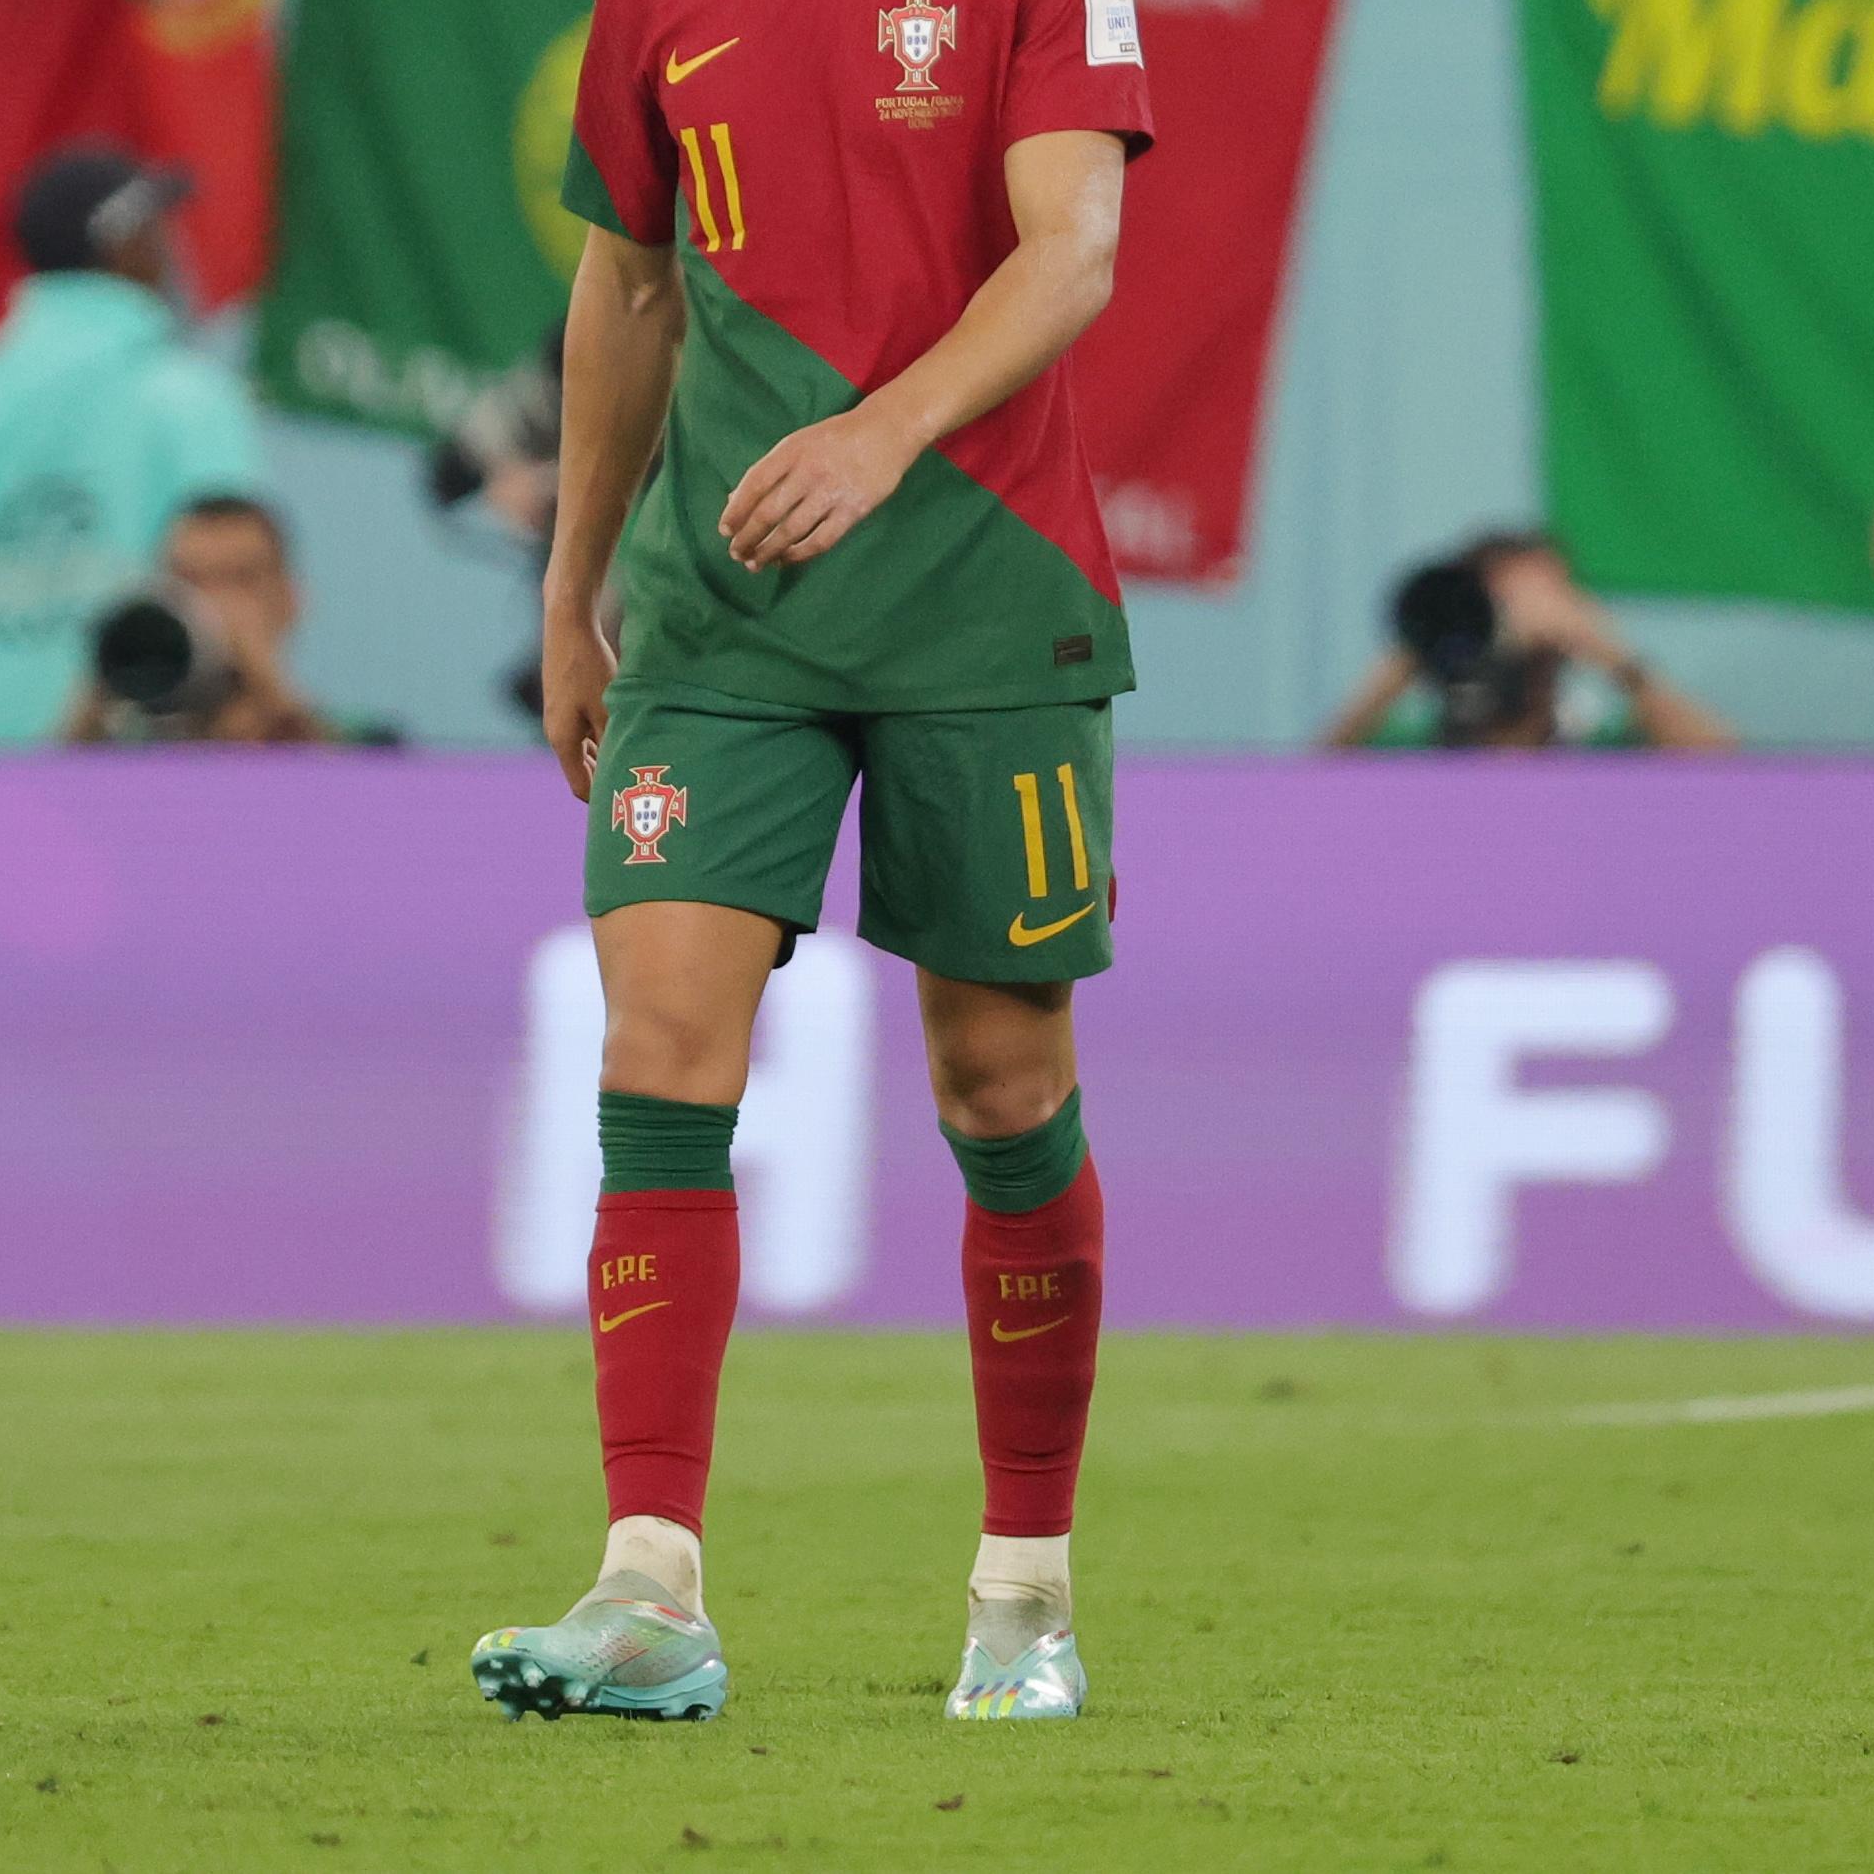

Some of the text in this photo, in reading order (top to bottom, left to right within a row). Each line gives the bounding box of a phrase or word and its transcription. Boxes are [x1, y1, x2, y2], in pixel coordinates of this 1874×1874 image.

[875, 96, 929, 109] PORTUGAL
[680, 122, 745, 252] 11
[1014, 763, 1089, 898] 11
